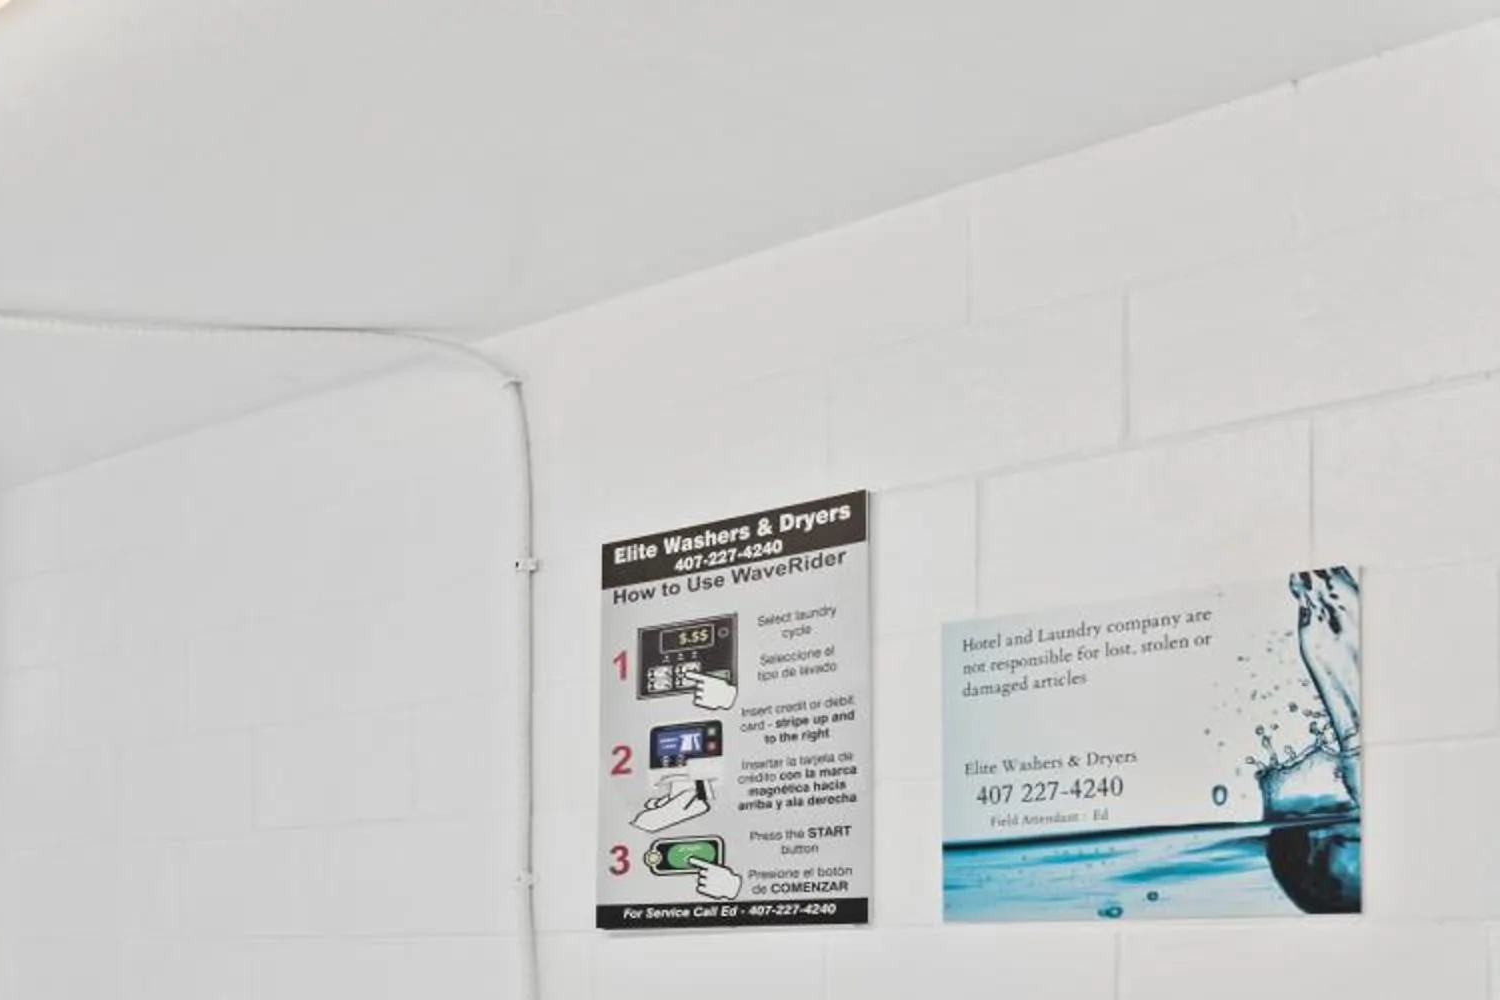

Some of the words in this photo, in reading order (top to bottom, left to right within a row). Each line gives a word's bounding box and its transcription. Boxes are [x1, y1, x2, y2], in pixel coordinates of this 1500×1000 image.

[614, 544, 658, 564] Elite
[663, 526, 750, 554] Washers
[757, 518, 773, 536] &
[780, 504, 851, 532] Dryers
[674, 540, 783, 571] 407-227-4240
[613, 588, 655, 604] How
[662, 582, 680, 596] to
[688, 575, 725, 592] Use
[731, 551, 847, 584] WaveRider
[757, 612, 792, 627] Select
[795, 605, 837, 621] laundry
[781, 624, 812, 640] cycle
[962, 633, 1001, 652] Hotel
[1005, 629, 1033, 648] and
[1038, 621, 1102, 644] Laundry
[1106, 612, 1182, 635] company
[1186, 609, 1213, 624] are
[824, 644, 836, 657] el
[962, 662, 987, 675] not
[990, 649, 1074, 674] responsible
[1077, 645, 1100, 661] for
[1141, 633, 1190, 653] stolen
[1194, 633, 1213, 647] or
[613, 650, 628, 681] 1
[782, 667, 796, 678] de
[799, 661, 838, 675] lavado
[962, 675, 1029, 698] damaged
[1033, 668, 1088, 689] articles
[741, 705, 773, 717] Insert
[775, 700, 806, 714] credit
[809, 700, 821, 711] or
[824, 695, 854, 709] debit
[740, 721, 765, 733] card
[775, 715, 809, 729] stripe
[813, 715, 829, 726] up
[831, 710, 855, 722] and
[764, 735, 777, 744] to
[779, 732, 798, 743] the
[801, 727, 830, 742] right
[611, 746, 632, 775] 2
[964, 760, 998, 776] Elite
[1002, 755, 1063, 773] Washers
[1067, 756, 1080, 768] &
[1086, 751, 1138, 768] Dryers
[779, 770, 802, 781] con
[805, 767, 816, 778] la
[819, 765, 857, 778] marca
[813, 779, 847, 792] hacia
[976, 784, 1013, 805] 407
[1021, 776, 1124, 803] 227-4240
[737, 799, 773, 811] arriba
[775, 800, 783, 811] y
[807, 793, 857, 806] derecha
[990, 812, 1018, 827] Field
[1093, 808, 1109, 821] Ed
[749, 830, 783, 841] Press
[785, 828, 805, 840] the
[807, 825, 853, 839] START
[609, 845, 631, 876] 3
[781, 844, 819, 855] button
[748, 869, 800, 879] Presione
[751, 884, 767, 895] de
[771, 880, 849, 893] COMENZAR
[623, 907, 643, 919] For
[645, 907, 690, 919] Service
[693, 904, 719, 917] Call
[721, 905, 739, 917] Ed
[748, 902, 838, 916] 407-227-4240
